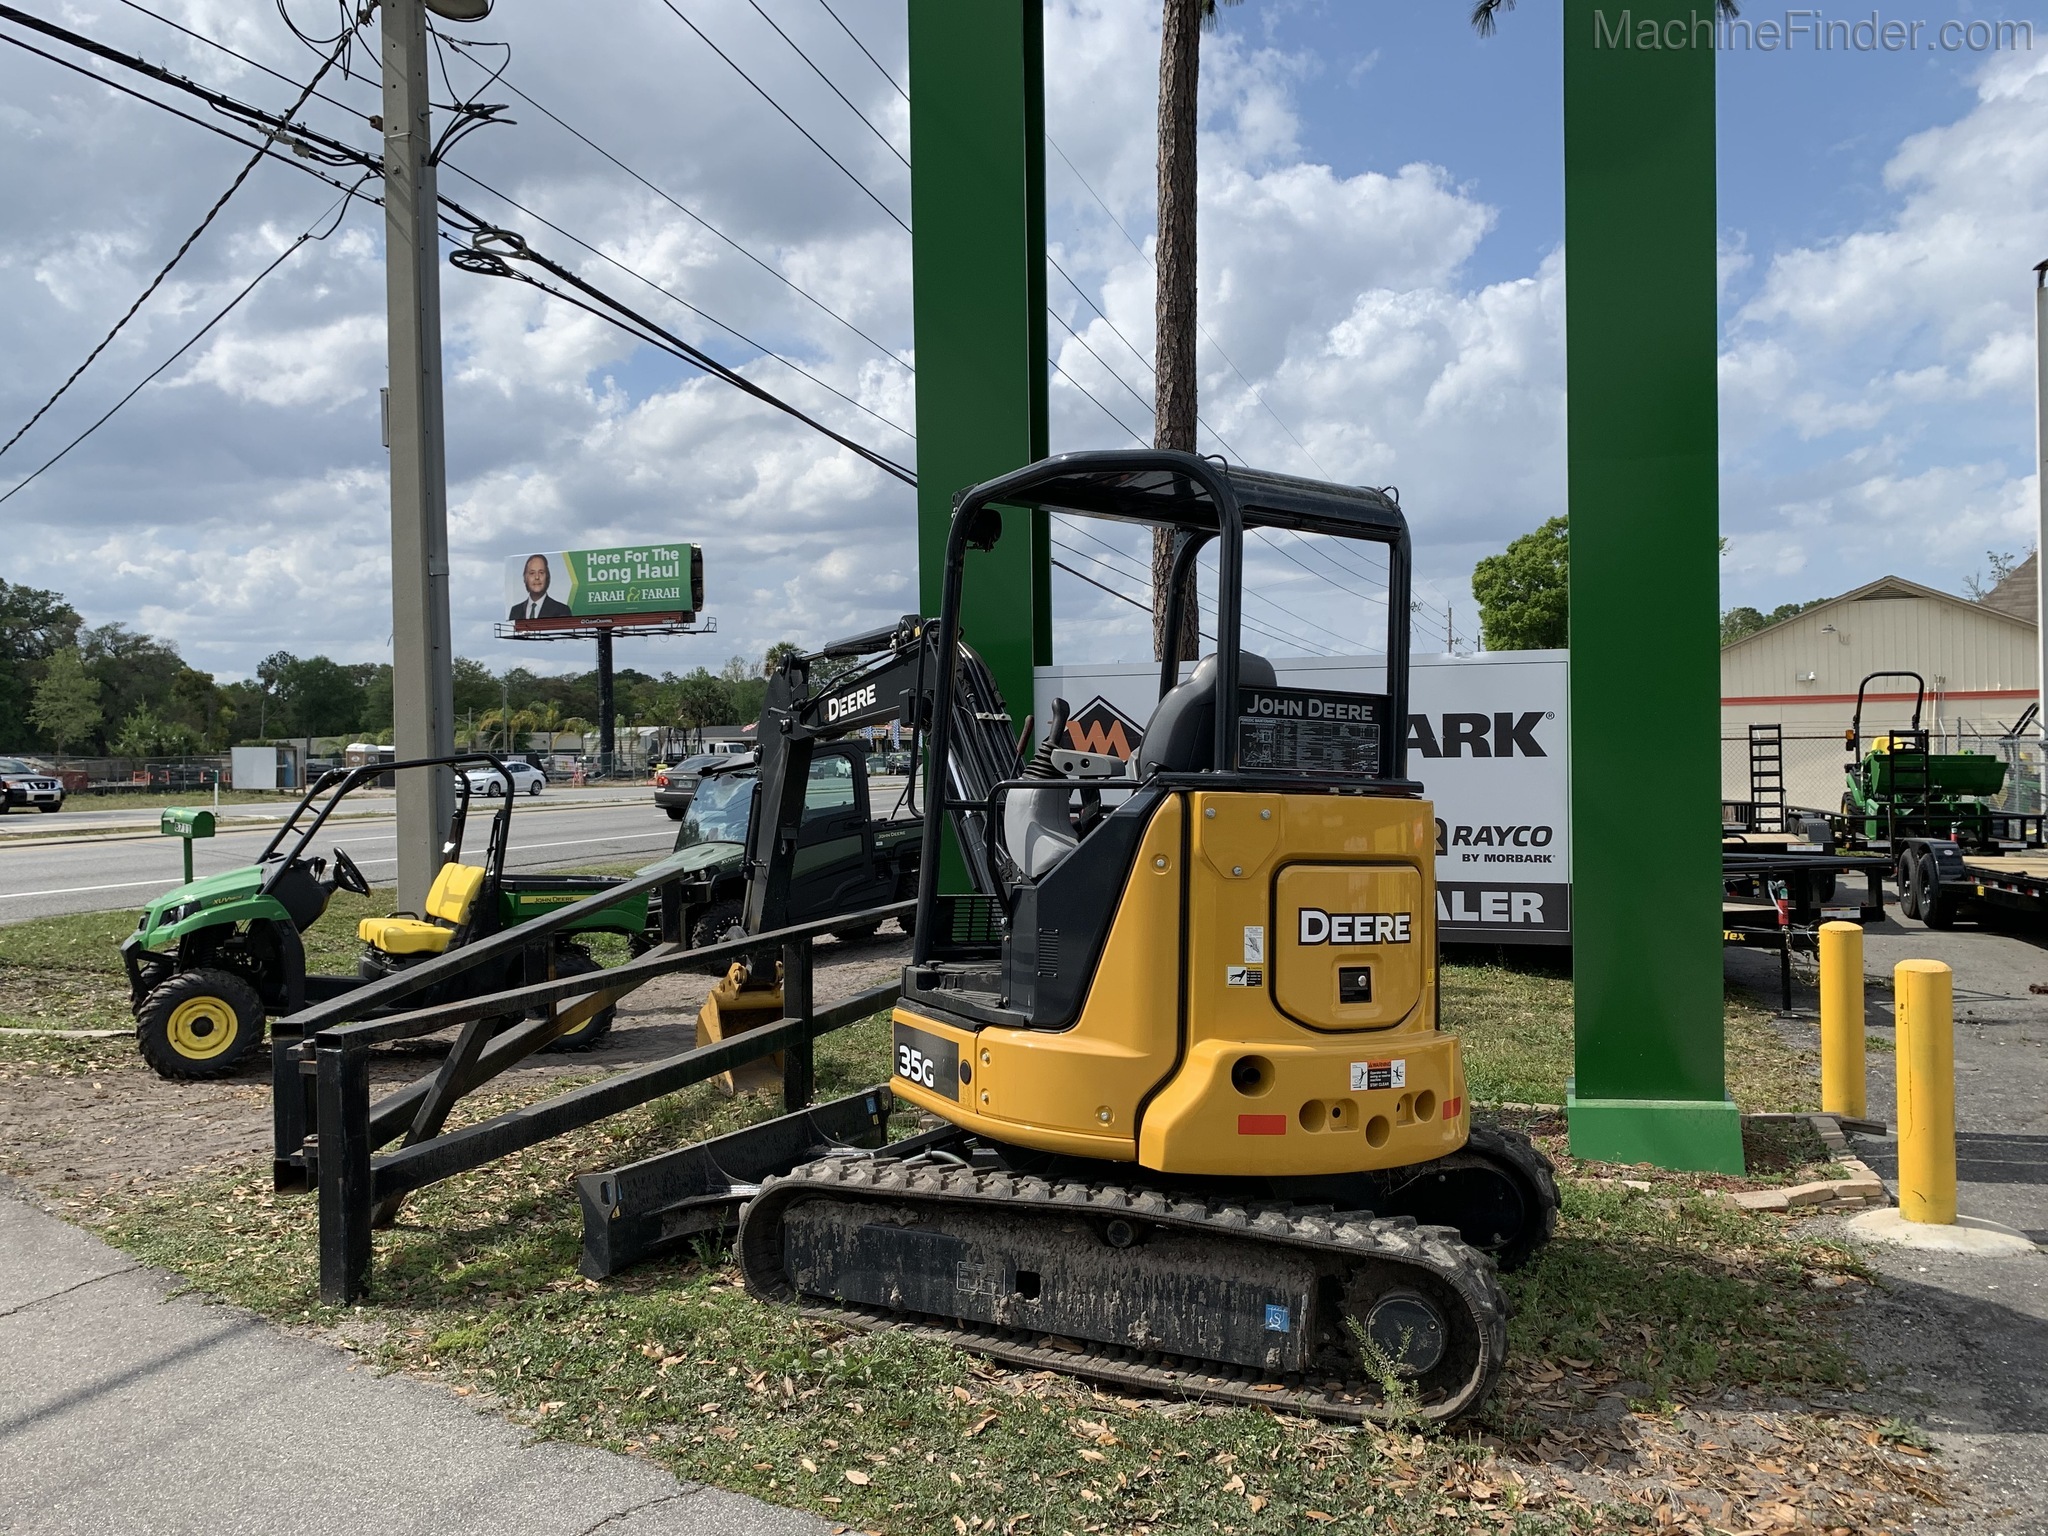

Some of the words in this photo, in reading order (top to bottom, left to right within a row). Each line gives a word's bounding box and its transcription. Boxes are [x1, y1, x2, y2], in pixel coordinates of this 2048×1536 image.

[587, 553, 621, 566] Here
[624, 550, 649, 563] For
[652, 548, 679, 561] The
[587, 567, 631, 584] Long
[637, 561, 679, 579] Haul
[588, 590, 625, 602] FARAH
[626, 586, 641, 603] &
[641, 587, 680, 600] FARAH
[828, 684, 876, 721] DEERE
[1247, 695, 1303, 717] JOHN
[1308, 698, 1373, 721] DEERE
[1452, 826, 1553, 847] RAYCO
[1462, 853, 1480, 862] BY
[1484, 853, 1552, 863] MORBARK
[1300, 909, 1410, 943] DEERE
[899, 1044, 934, 1088] 35G
